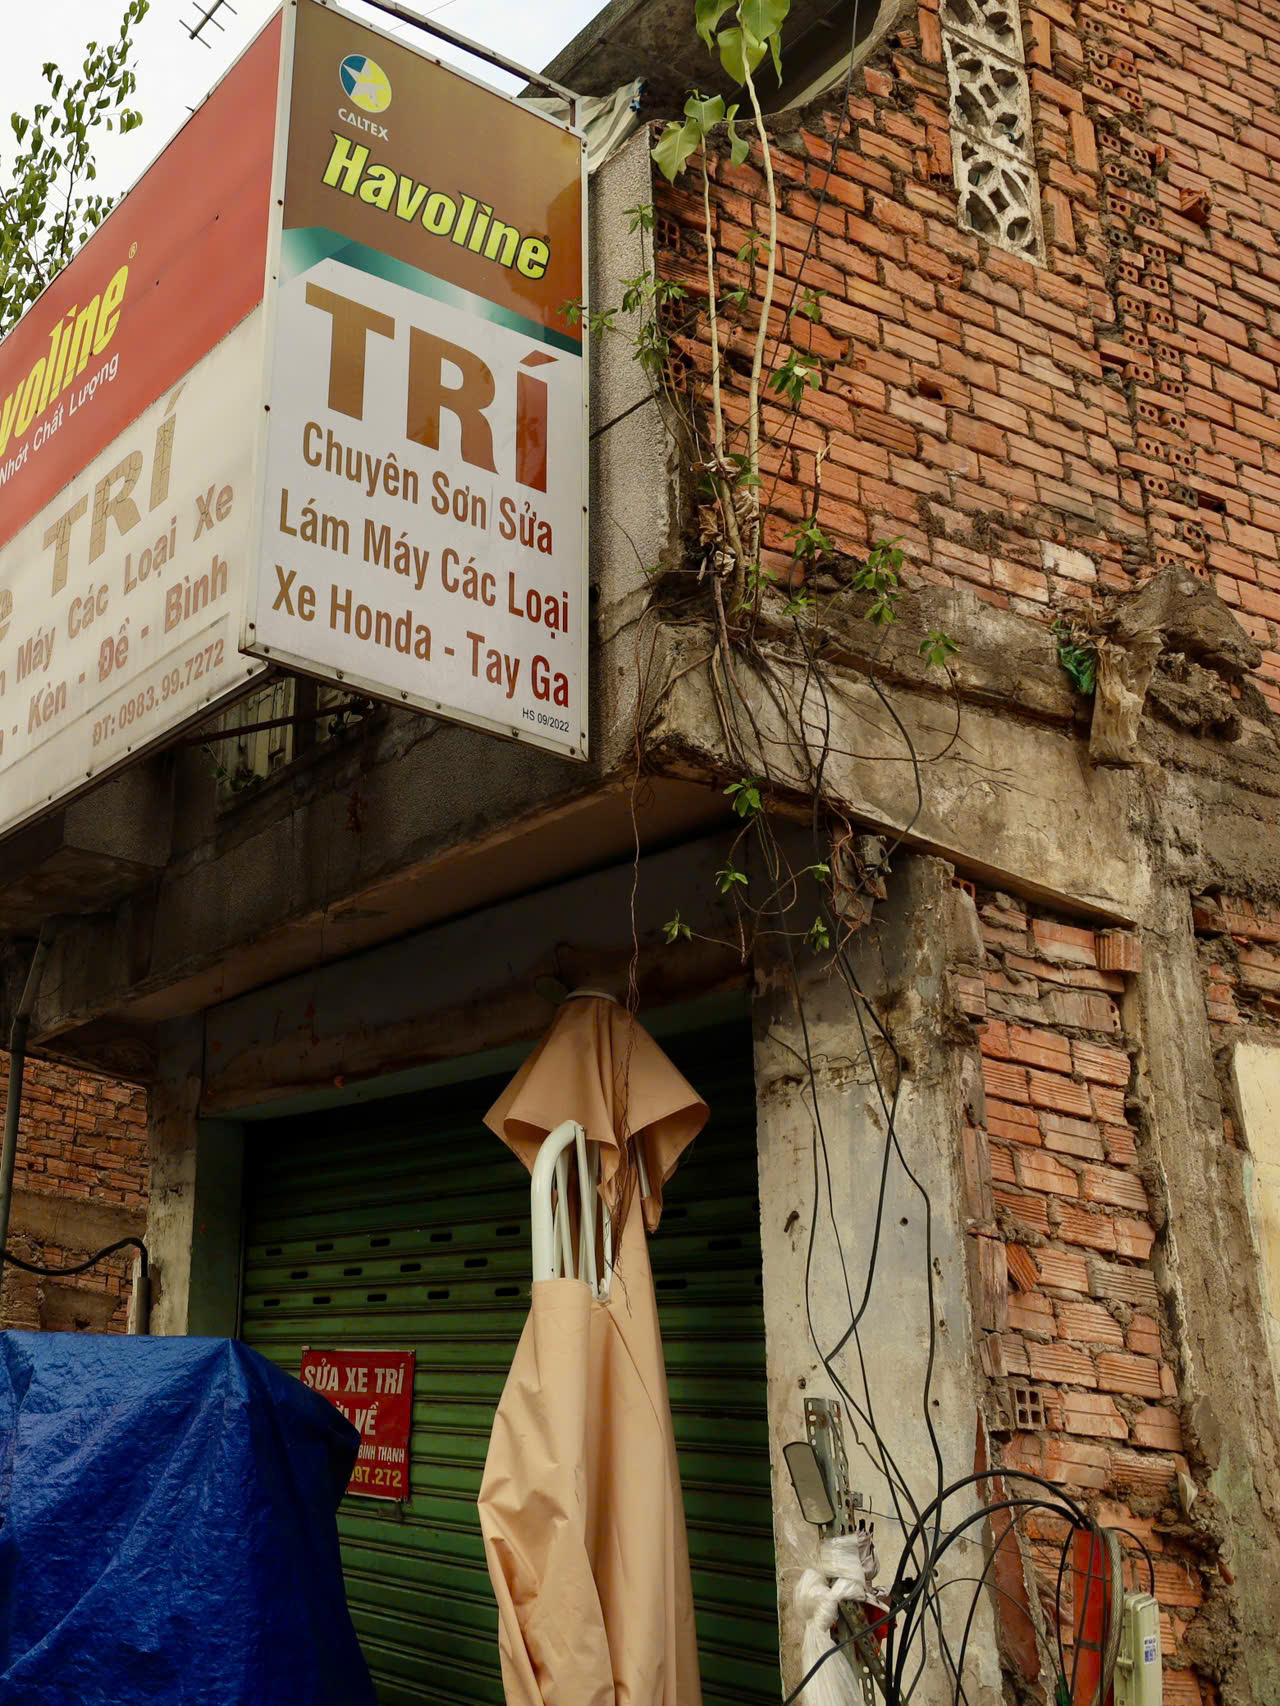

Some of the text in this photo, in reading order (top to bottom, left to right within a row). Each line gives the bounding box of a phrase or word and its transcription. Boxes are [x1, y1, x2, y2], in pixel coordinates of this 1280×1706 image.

[337, 108, 389, 141] CALTEX
[321, 131, 551, 280] Havoline
[33, 404, 64, 451] Chất
[69, 354, 120, 417] Lượng
[305, 281, 559, 494] TRÍ
[42, 381, 189, 597] TRÍ
[303, 421, 553, 555] Chuyên Sơn Sửa
[16, 626, 56, 684] Máy
[68, 583, 109, 640] Các
[124, 516, 178, 595] Loại
[193, 484, 234, 542] Xe
[279, 488, 569, 639] Lám Máy Các Loại
[28, 674, 67, 734] Kèn
[98, 616, 129, 683] Đề
[165, 554, 229, 634] Bình
[119, 638, 226, 730] 0983.99.7272
[272, 564, 569, 708] Xe Honda Tay Ga
[521, 707, 570, 733] HS 09/2022
[303, 1358, 407, 1394] SỬA XE TRÍ
[354, 1401, 379, 1436] VỀ
[377, 1446, 405, 1466] THẠNH
